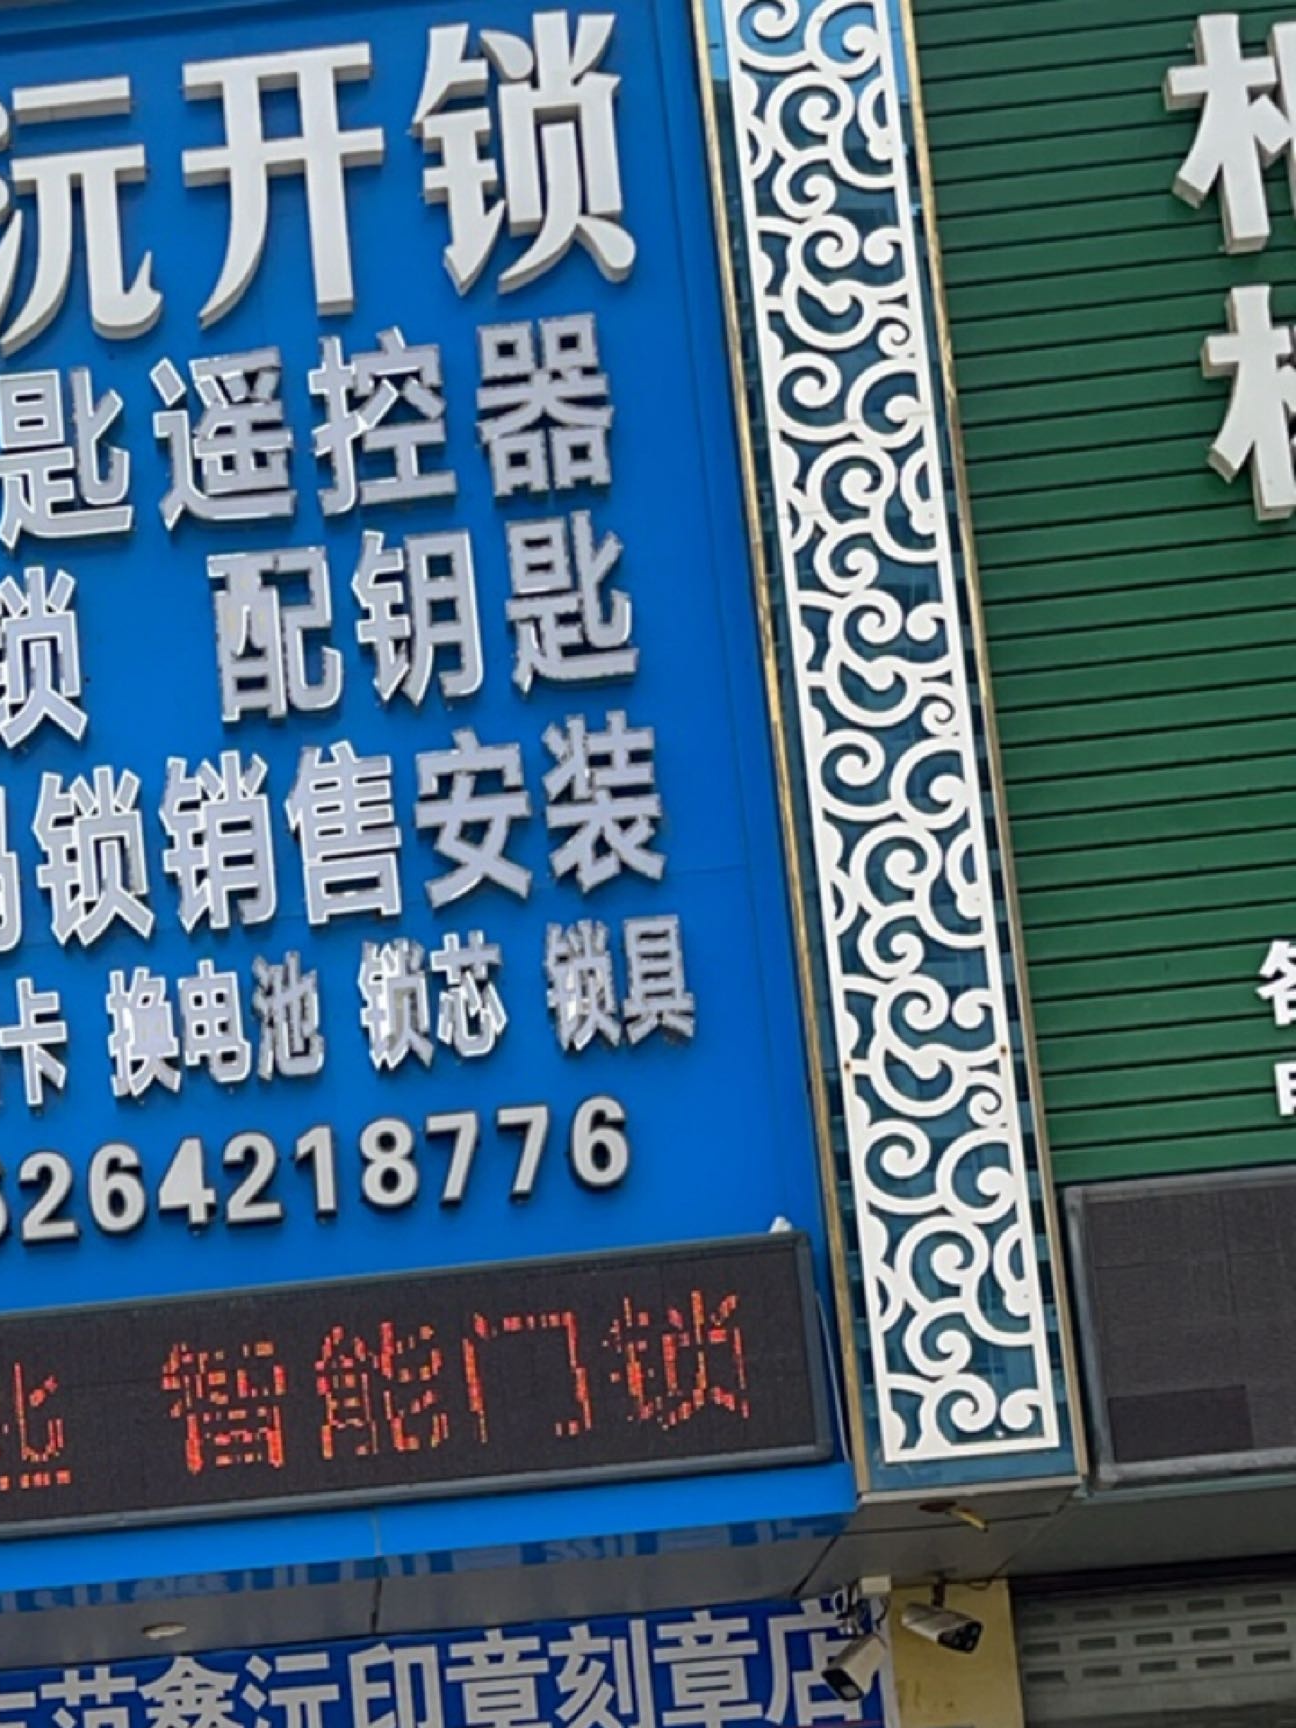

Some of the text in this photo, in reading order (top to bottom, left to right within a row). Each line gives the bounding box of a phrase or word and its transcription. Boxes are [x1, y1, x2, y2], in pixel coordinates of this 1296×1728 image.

[208, 509, 636, 721] 配钥匙
[106, 951, 324, 1098] 换电池
[359, 932, 505, 1072] 锁芯
[546, 915, 697, 1055] 锁具
[161, 1290, 752, 1475] 智能门锁
